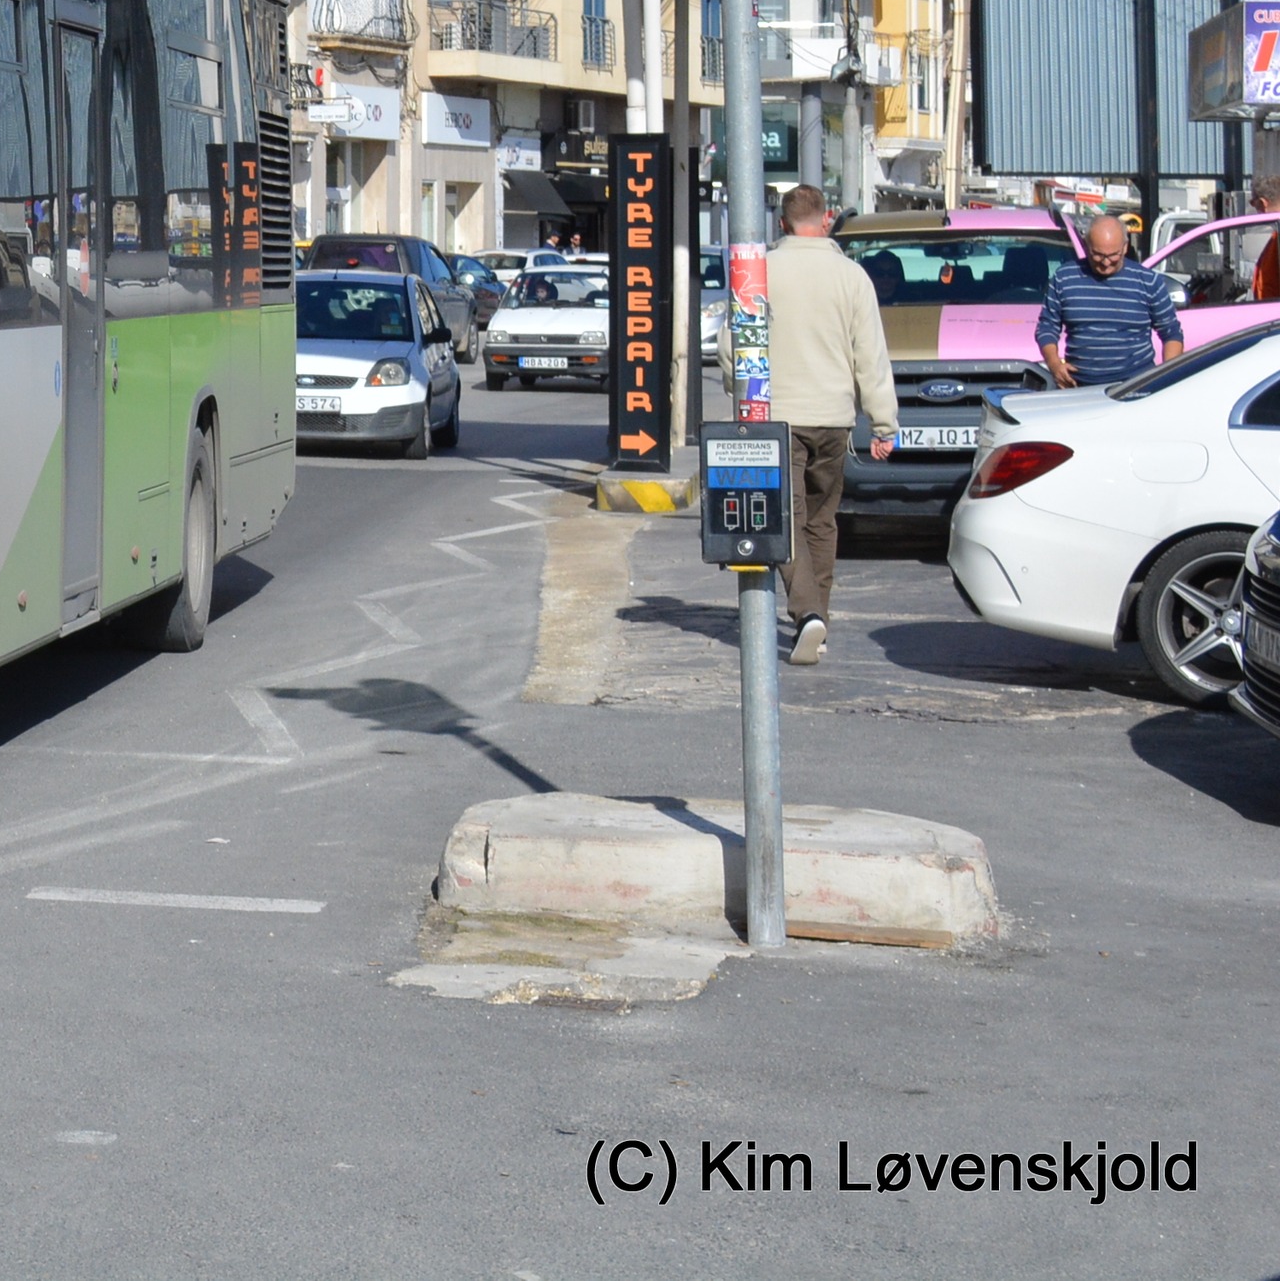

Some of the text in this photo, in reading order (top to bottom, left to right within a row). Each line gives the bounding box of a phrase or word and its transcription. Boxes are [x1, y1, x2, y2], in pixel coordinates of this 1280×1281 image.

[627, 153, 653, 248] TYRE
[627, 266, 653, 412] REPAIR
[928, 385, 955, 397] Ford
[311, 399, 337, 410] 574
[901, 429, 924, 445] MZ
[937, 430, 958, 445] IQ
[716, 442, 771, 450] PEDESTRIANS
[716, 468, 774, 486] WAIT
